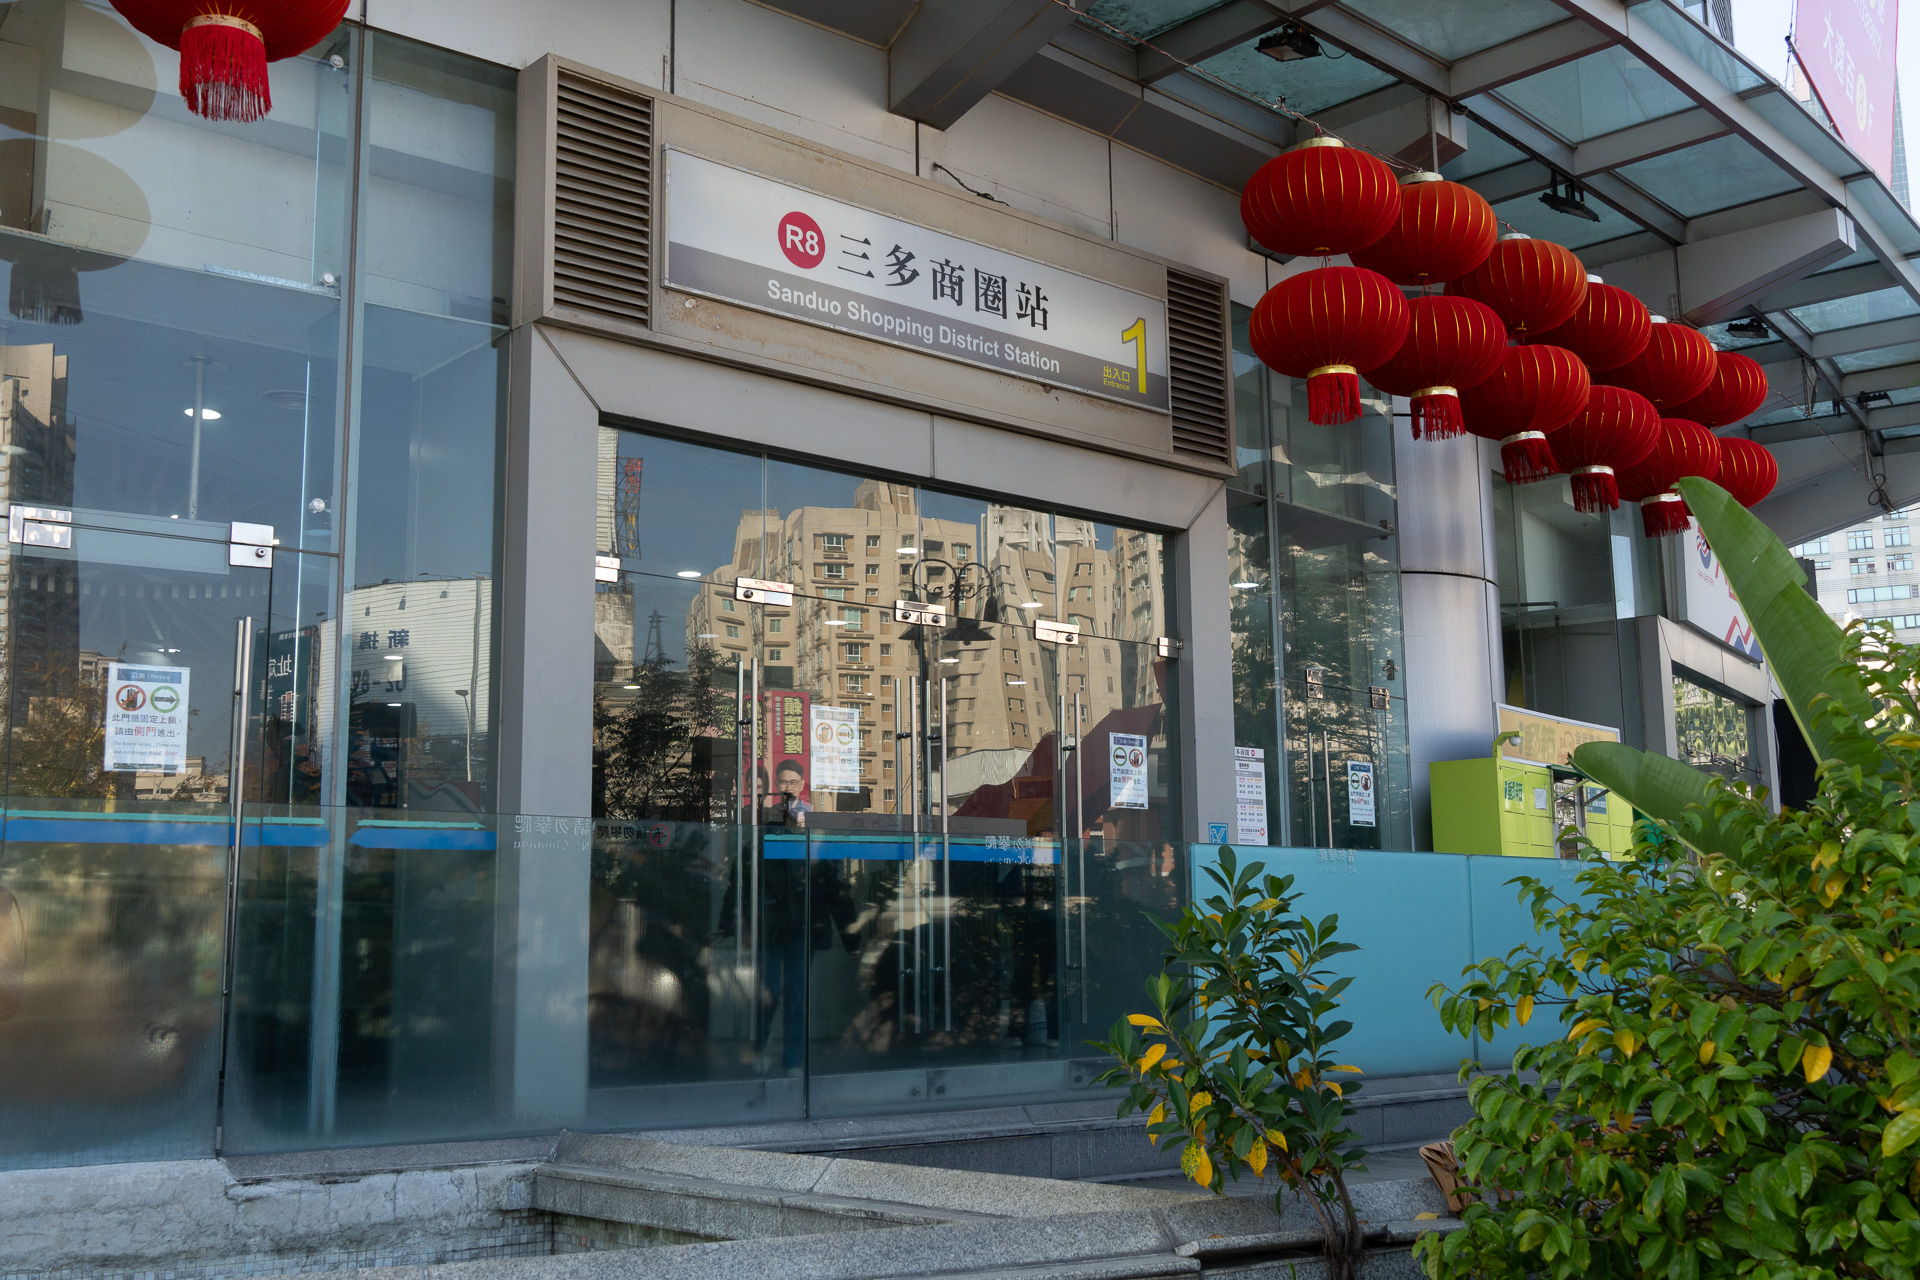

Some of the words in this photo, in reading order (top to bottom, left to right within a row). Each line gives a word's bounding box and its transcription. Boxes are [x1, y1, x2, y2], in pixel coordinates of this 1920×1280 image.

[785, 224, 820, 257] R8
[837, 233, 1049, 331] 三多商圈站
[767, 279, 842, 316] Sanduo
[847, 300, 934, 345] Shopping
[939, 325, 1000, 360] District
[1004, 342, 1061, 374] Station
[1102, 365, 1131, 383] 出入口
[1121, 317, 1147, 394] 1
[1103, 378, 1131, 392] Entrance
